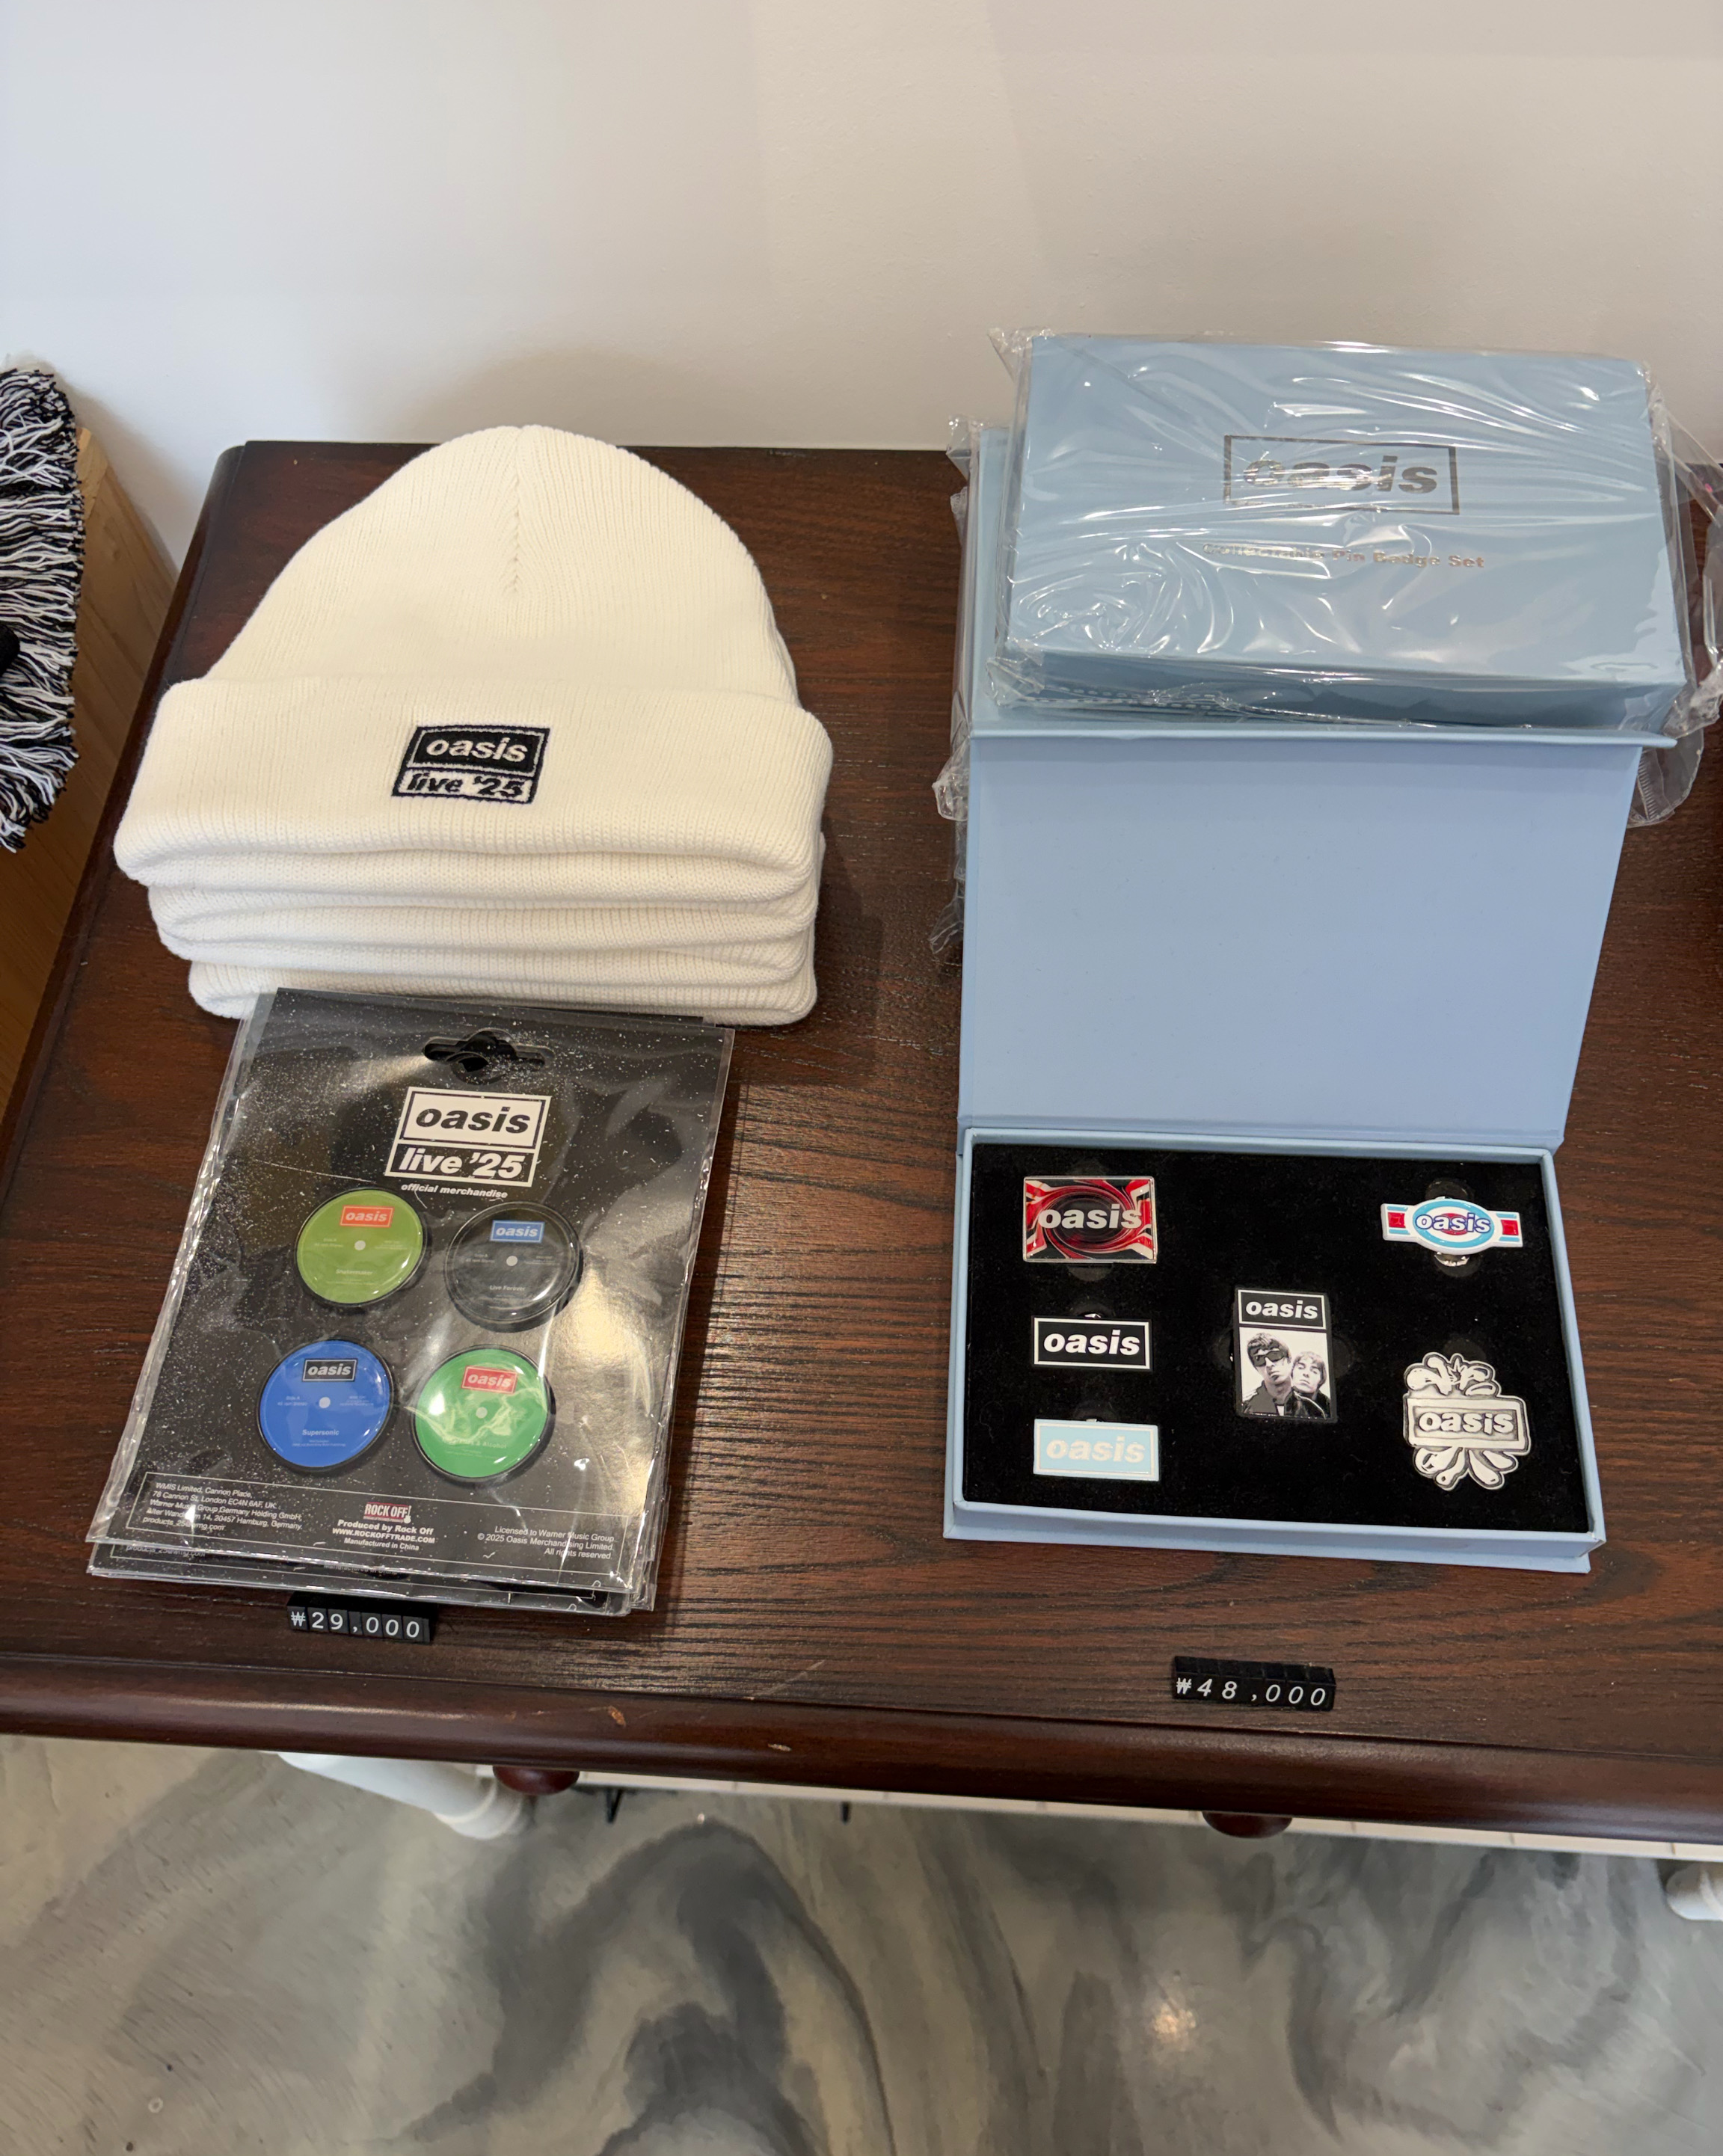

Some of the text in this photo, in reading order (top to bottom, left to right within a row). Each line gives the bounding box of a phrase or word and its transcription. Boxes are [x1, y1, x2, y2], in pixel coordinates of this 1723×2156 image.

[1243, 455, 1437, 494] oasis
[1332, 549, 1366, 562] Pin
[1373, 550, 1441, 568] Badge
[1449, 554, 1485, 568] Set
[426, 737, 528, 762] oasis
[407, 773, 463, 793] live
[416, 1106, 530, 1134] oasis
[399, 1147, 526, 1179] live '25
[401, 1183, 508, 1199] official merchandise
[345, 1210, 388, 1222] oasis
[1038, 1203, 1143, 1229] oasis
[1415, 1212, 1492, 1234] oasis
[496, 1226, 538, 1238] oasis
[1246, 1300, 1318, 1319] oasis
[1043, 1329, 1140, 1356] oasis
[307, 1363, 351, 1375] oasis
[467, 1373, 512, 1388] oasis
[1419, 1411, 1514, 1434] oasis
[1046, 1436, 1146, 1464] oasis
[156, 1482, 176, 1490] WMIS
[205, 1487, 231, 1496] Cannon
[163, 1492, 188, 1500] Cannon
[201, 1496, 227, 1504] London
[228, 1498, 248, 1506] EC4N
[150, 1499, 174, 1508] Warner
[175, 1502, 196, 1511] Mus
[197, 1504, 218, 1513] Group
[219, 1506, 251, 1516] Germany
[251, 1510, 277, 1519] Holding
[165, 1510, 201, 1519] Wandm
[364, 1503, 390, 1517] ROCK
[332, 1527, 435, 1544] WWW.ROCKOFFTRADE.COM
[337, 1519, 380, 1531] Produced
[381, 1523, 393, 1532] by
[395, 1525, 417, 1533] Rock
[495, 1526, 528, 1535] Licensed
[538, 1529, 565, 1538] Warner
[567, 1532, 589, 1541] Music
[344, 1538, 390, 1548] Manufactured
[399, 1543, 420, 1551] China
[485, 1534, 505, 1543] 2025
[506, 1535, 528, 1544] Oasis
[529, 1538, 583, 1550] Merchandsing
[585, 1542, 614, 1551] Limited.
[291, 1612, 420, 1638] ₩29,000
[1176, 1677, 1326, 1706] ₩48,000
